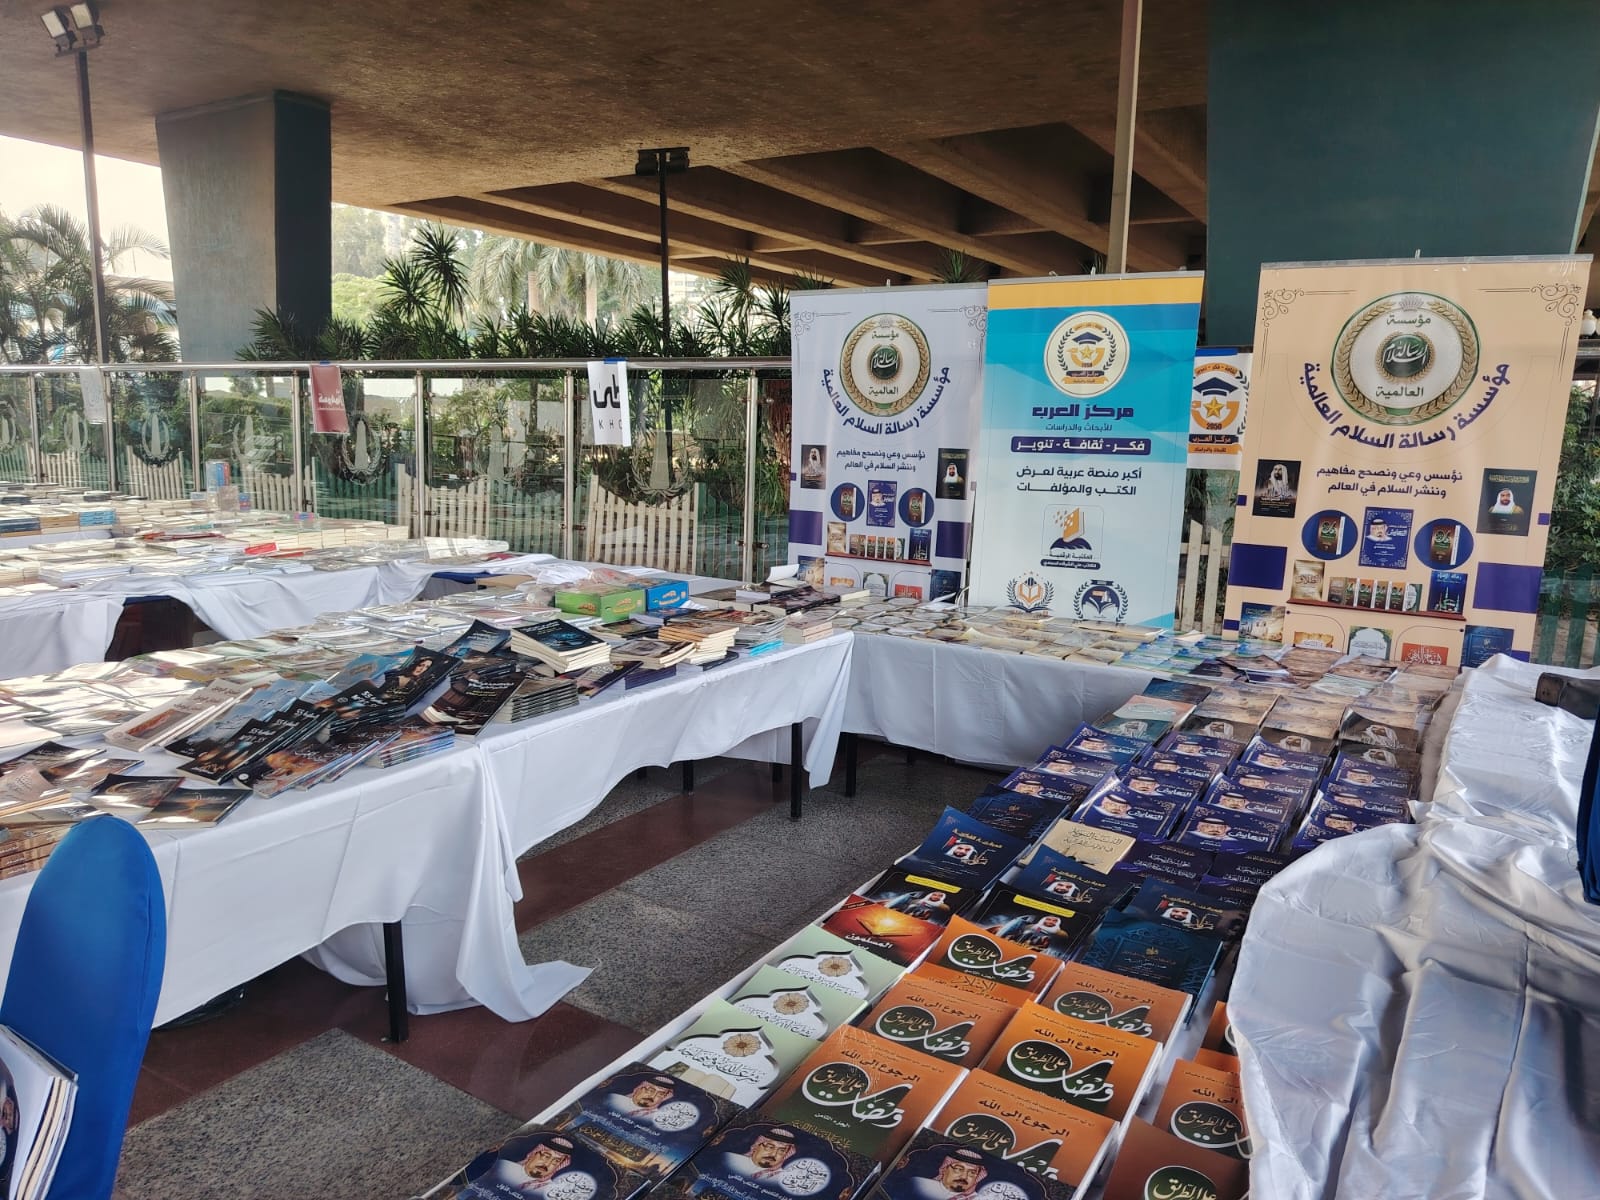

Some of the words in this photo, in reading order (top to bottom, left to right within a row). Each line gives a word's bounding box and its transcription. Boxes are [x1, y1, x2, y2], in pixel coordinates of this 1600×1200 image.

[1386, 314, 1431, 326] مؤسسة
[821, 368, 849, 417] العالمية
[869, 387, 899, 396] العالمية
[918, 367, 951, 419] مؤسسة
[1300, 362, 1342, 425] العالمية
[1376, 386, 1424, 399] العالمية
[1454, 363, 1510, 430] مؤسسة
[1032, 403, 1080, 419] العرب
[1083, 405, 1134, 420] مركز
[843, 416, 882, 434] السلام
[885, 417, 919, 435] رسالة
[1045, 423, 1081, 432] والدراسات
[1084, 423, 1113, 431] للأبحاث
[1330, 424, 1394, 449] السلام
[1398, 426, 1456, 449] رسالة
[1017, 438, 1053, 452] تنوير
[1063, 438, 1103, 449] ثقافة
[1112, 439, 1145, 453] فكر
[837, 448, 860, 458] مفاهيم
[887, 451, 900, 460] وعي
[902, 450, 925, 460] نؤسس
[845, 461, 863, 470] العالم
[864, 462, 874, 471] في
[875, 462, 895, 471] السلام
[896, 463, 916, 472] وننشر
[1316, 465, 1356, 478] مفاهيم
[1017, 467, 1054, 478] لعرض
[1057, 467, 1084, 478] عربية
[1088, 468, 1119, 478] منصة
[1122, 468, 1142, 481] أكبر
[1358, 466, 1397, 480] ونصحح
[1398, 469, 1422, 482] وعي
[1424, 467, 1463, 482] نؤسس
[1017, 482, 1091, 496] والمؤلفات
[1095, 486, 1136, 496] الكتب
[1328, 482, 1358, 494] العالم
[1360, 483, 1376, 496] في
[1377, 485, 1412, 496] السلام
[1413, 485, 1447, 499] وننشر
[1076, 981, 1094, 989] الله
[906, 995, 924, 1003] الله
[1114, 992, 1154, 1004] الرجوع
[941, 1006, 981, 1020] الرجوع
[1034, 1028, 1054, 1038] الله
[841, 1050, 860, 1060] الله
[1015, 1047, 1058, 1065] الطريق
[1075, 1042, 1119, 1057] الرجوع
[879, 1064, 920, 1082] الرجوع
[1192, 1087, 1215, 1098] الله
[978, 1099, 1000, 1111] الله
[952, 1121, 1000, 1143] الطريق
[1022, 1116, 1070, 1137] الرجوع
